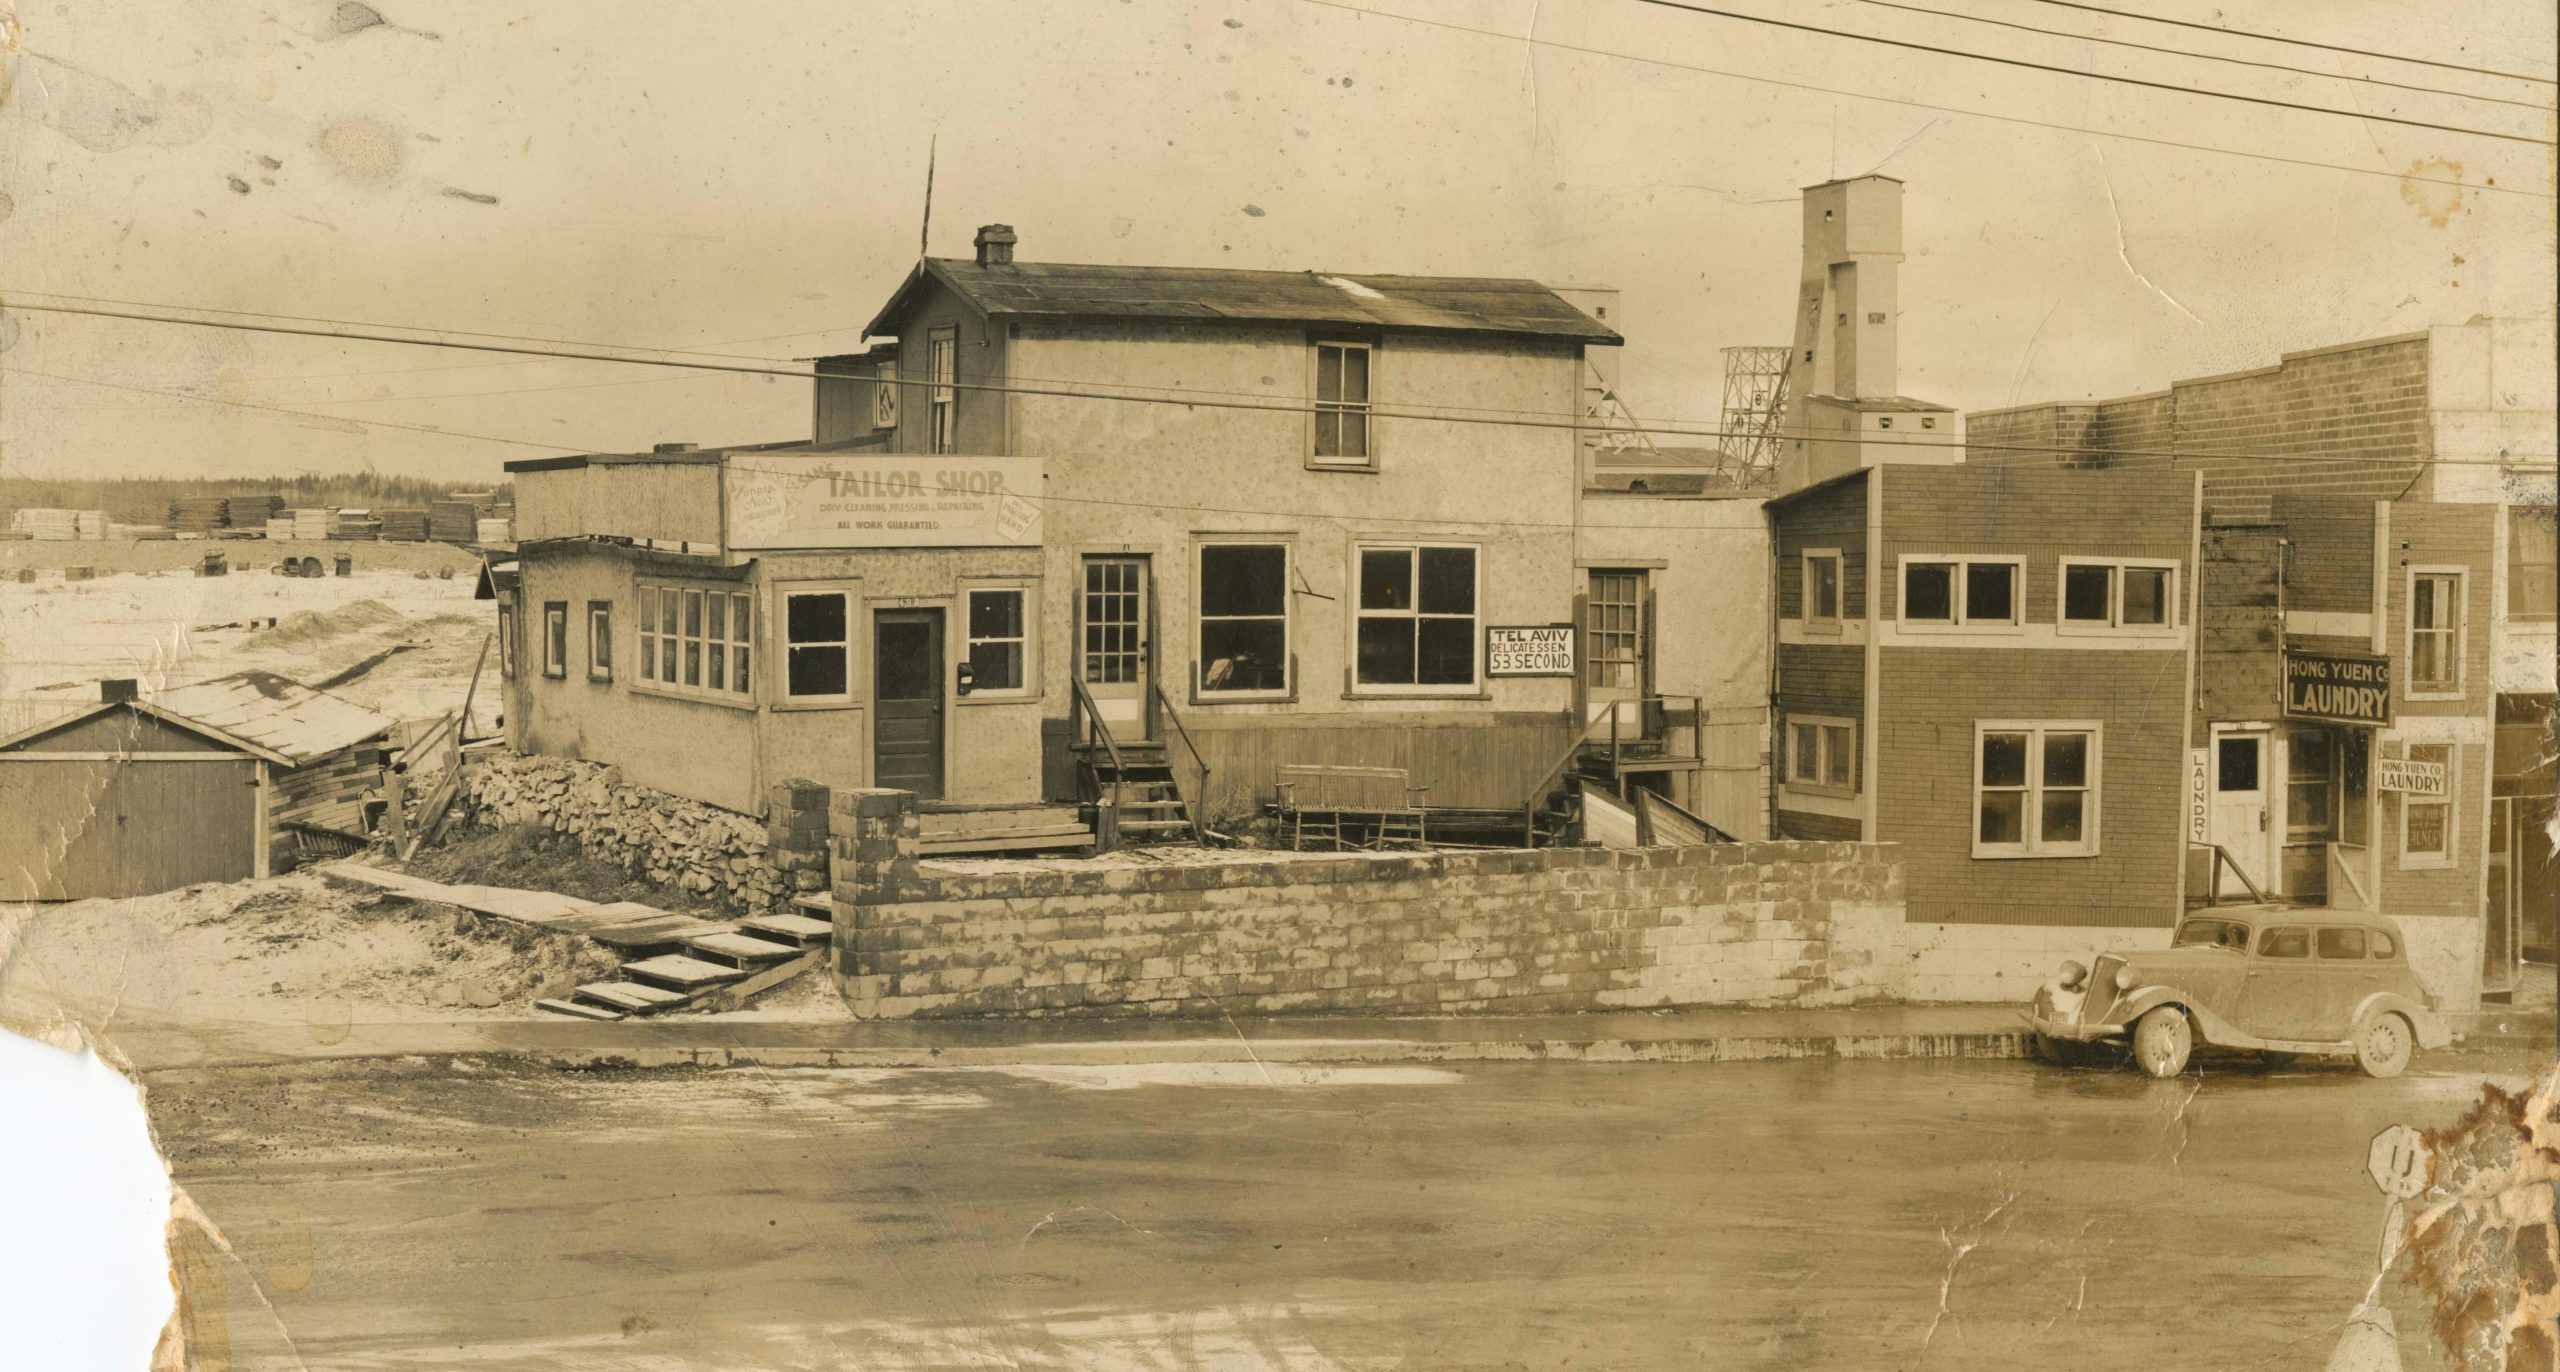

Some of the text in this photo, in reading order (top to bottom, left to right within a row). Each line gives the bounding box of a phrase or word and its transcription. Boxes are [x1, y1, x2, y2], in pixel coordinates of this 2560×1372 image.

[823, 470, 1005, 499] TAILOR SHOP
[819, 503, 841, 512] DRY
[936, 501, 984, 512] REPAIRING
[837, 521, 850, 529] ALL
[855, 521, 883, 529] WORK
[1495, 630, 1568, 642] TEL AVIV
[1491, 643, 1566, 653] DELICATESSEN
[1492, 653, 1571, 670] 53 SECOND
[2289, 659, 2327, 678] HONG
[2330, 662, 2372, 682] YUEN
[2289, 682, 2388, 718] LAUNDRY
[2382, 761, 2403, 773] HONG
[2404, 763, 2427, 774] YUEN
[2382, 772, 2442, 792] LAUNDRY
[2193, 755, 2205, 840] LAUNDRY
[2408, 829, 2442, 848] AUNDRY
[2386, 1177, 2411, 1192] TRN
